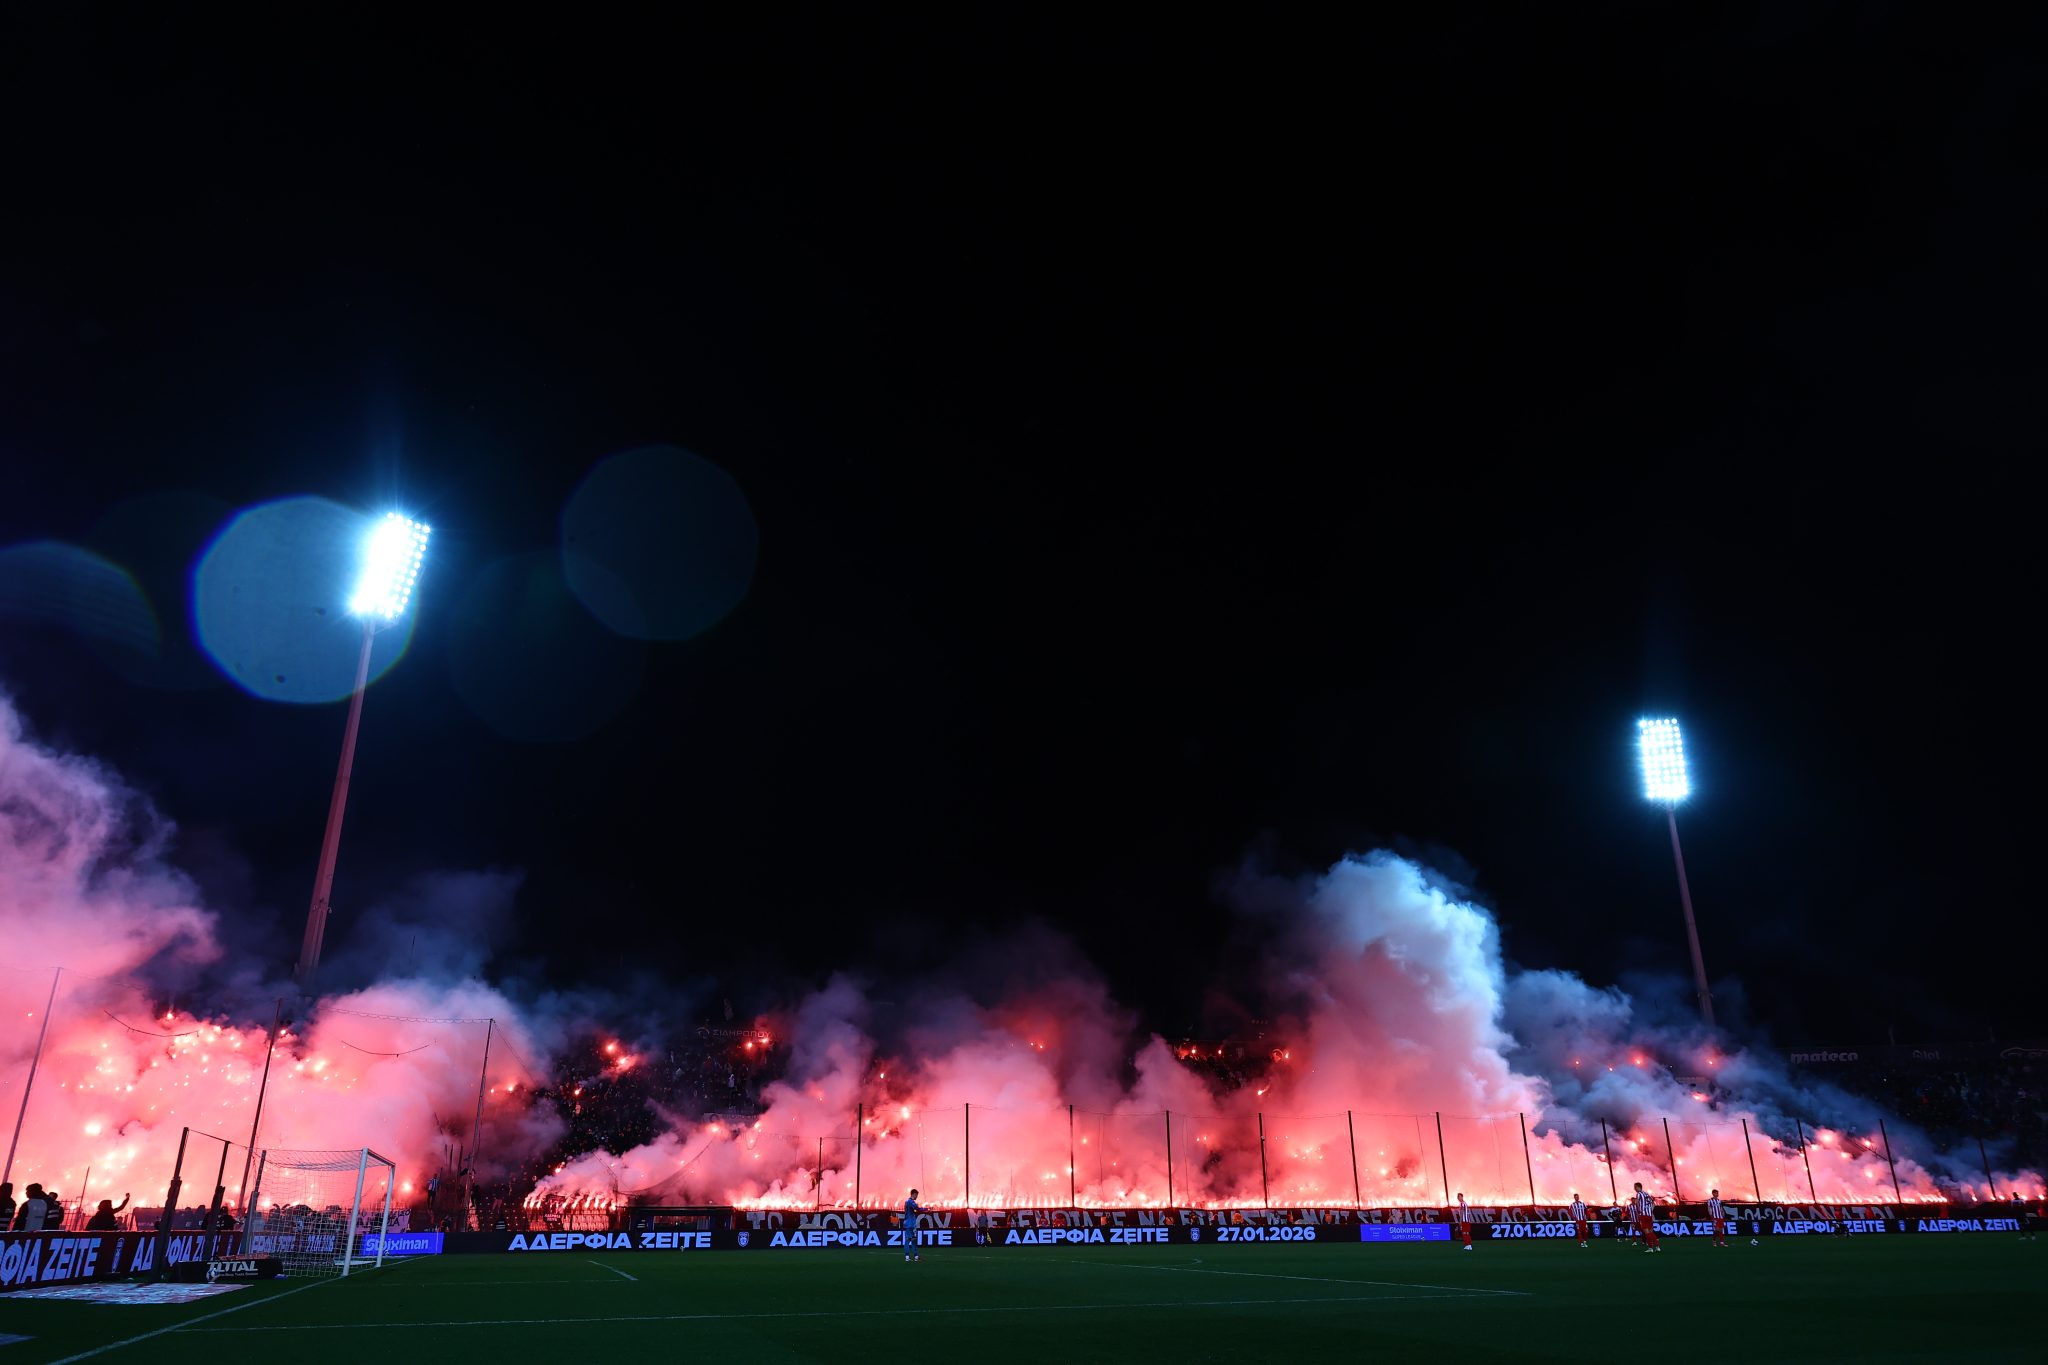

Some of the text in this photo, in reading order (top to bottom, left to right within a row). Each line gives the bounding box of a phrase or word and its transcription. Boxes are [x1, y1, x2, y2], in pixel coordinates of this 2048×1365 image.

[1790, 1051, 1858, 1063] mateco
[1217, 1226, 1316, 1241] 27.01.2026
[1491, 1223, 1576, 1238] 27.01.2026
[1918, 1219, 1983, 1232] ΑΔΕΡΦΙΑ
[508, 1231, 712, 1250] ΑΔΕΡΦΙΑ ΖΕΙΤΕ
[770, 1231, 881, 1247] ΑΔΕΡΦΙΑ
[1005, 1227, 1169, 1244] ΑΔΕΡΦΙΑ ΖΕΙΤΕ
[130, 1235, 194, 1271] ΑΔΦΙΑ
[0, 1237, 102, 1286] ΦΙΑ ΖΕΙΤΕ
